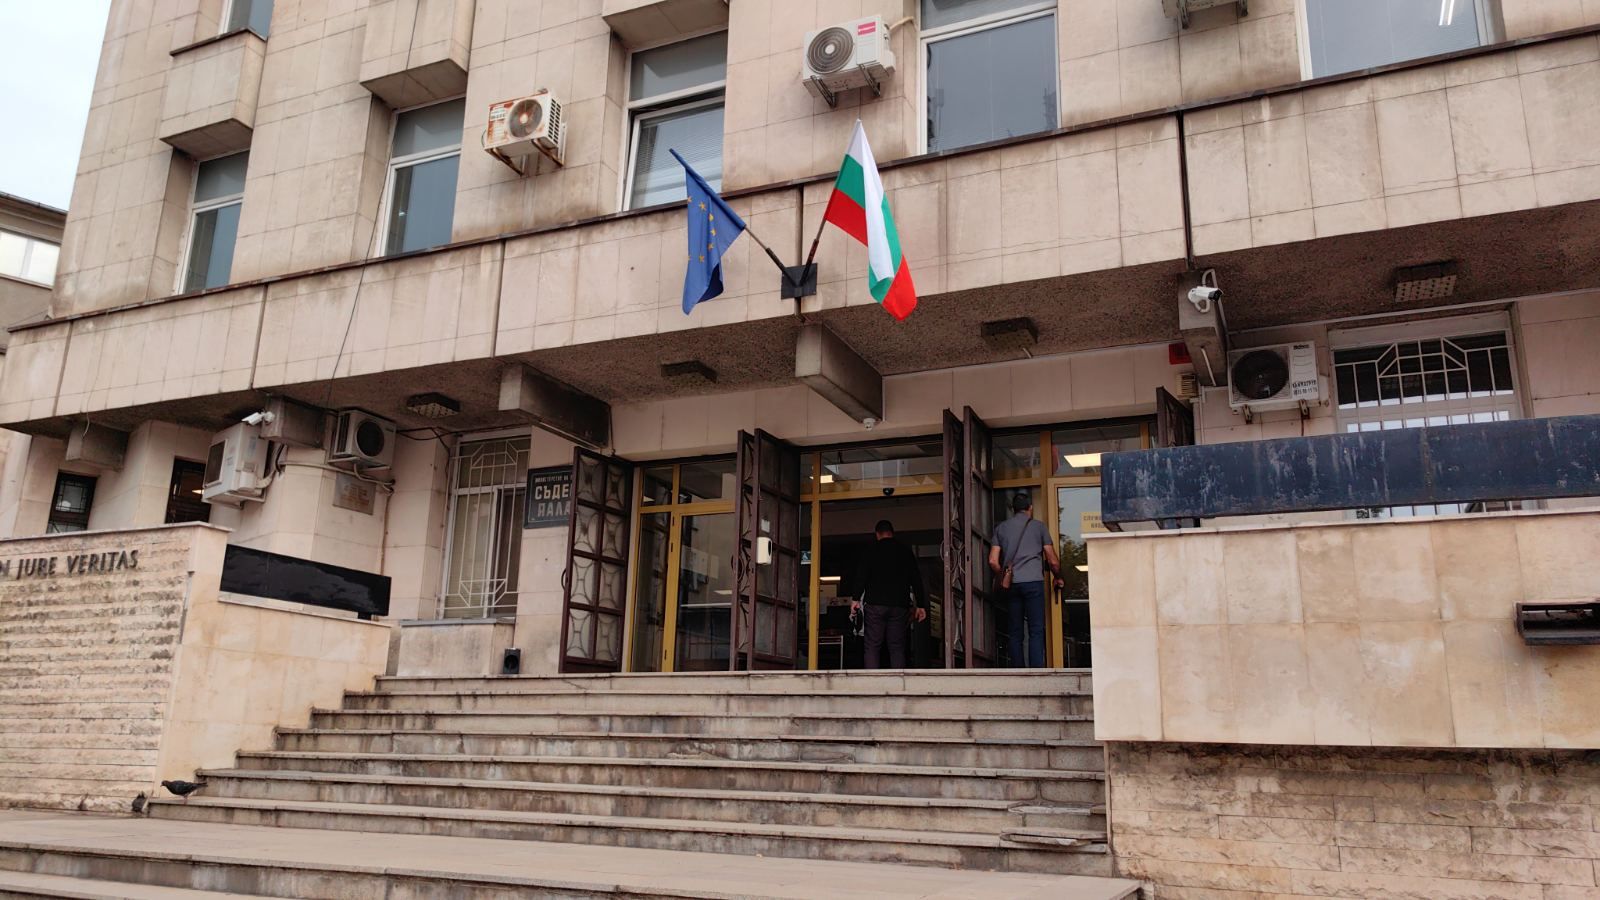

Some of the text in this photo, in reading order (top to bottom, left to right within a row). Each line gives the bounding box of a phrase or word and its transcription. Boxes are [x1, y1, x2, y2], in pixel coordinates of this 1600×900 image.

[535, 483, 572, 500] СЪДЕ
[16, 557, 58, 580] JURE
[67, 550, 139, 574] VERITAS
